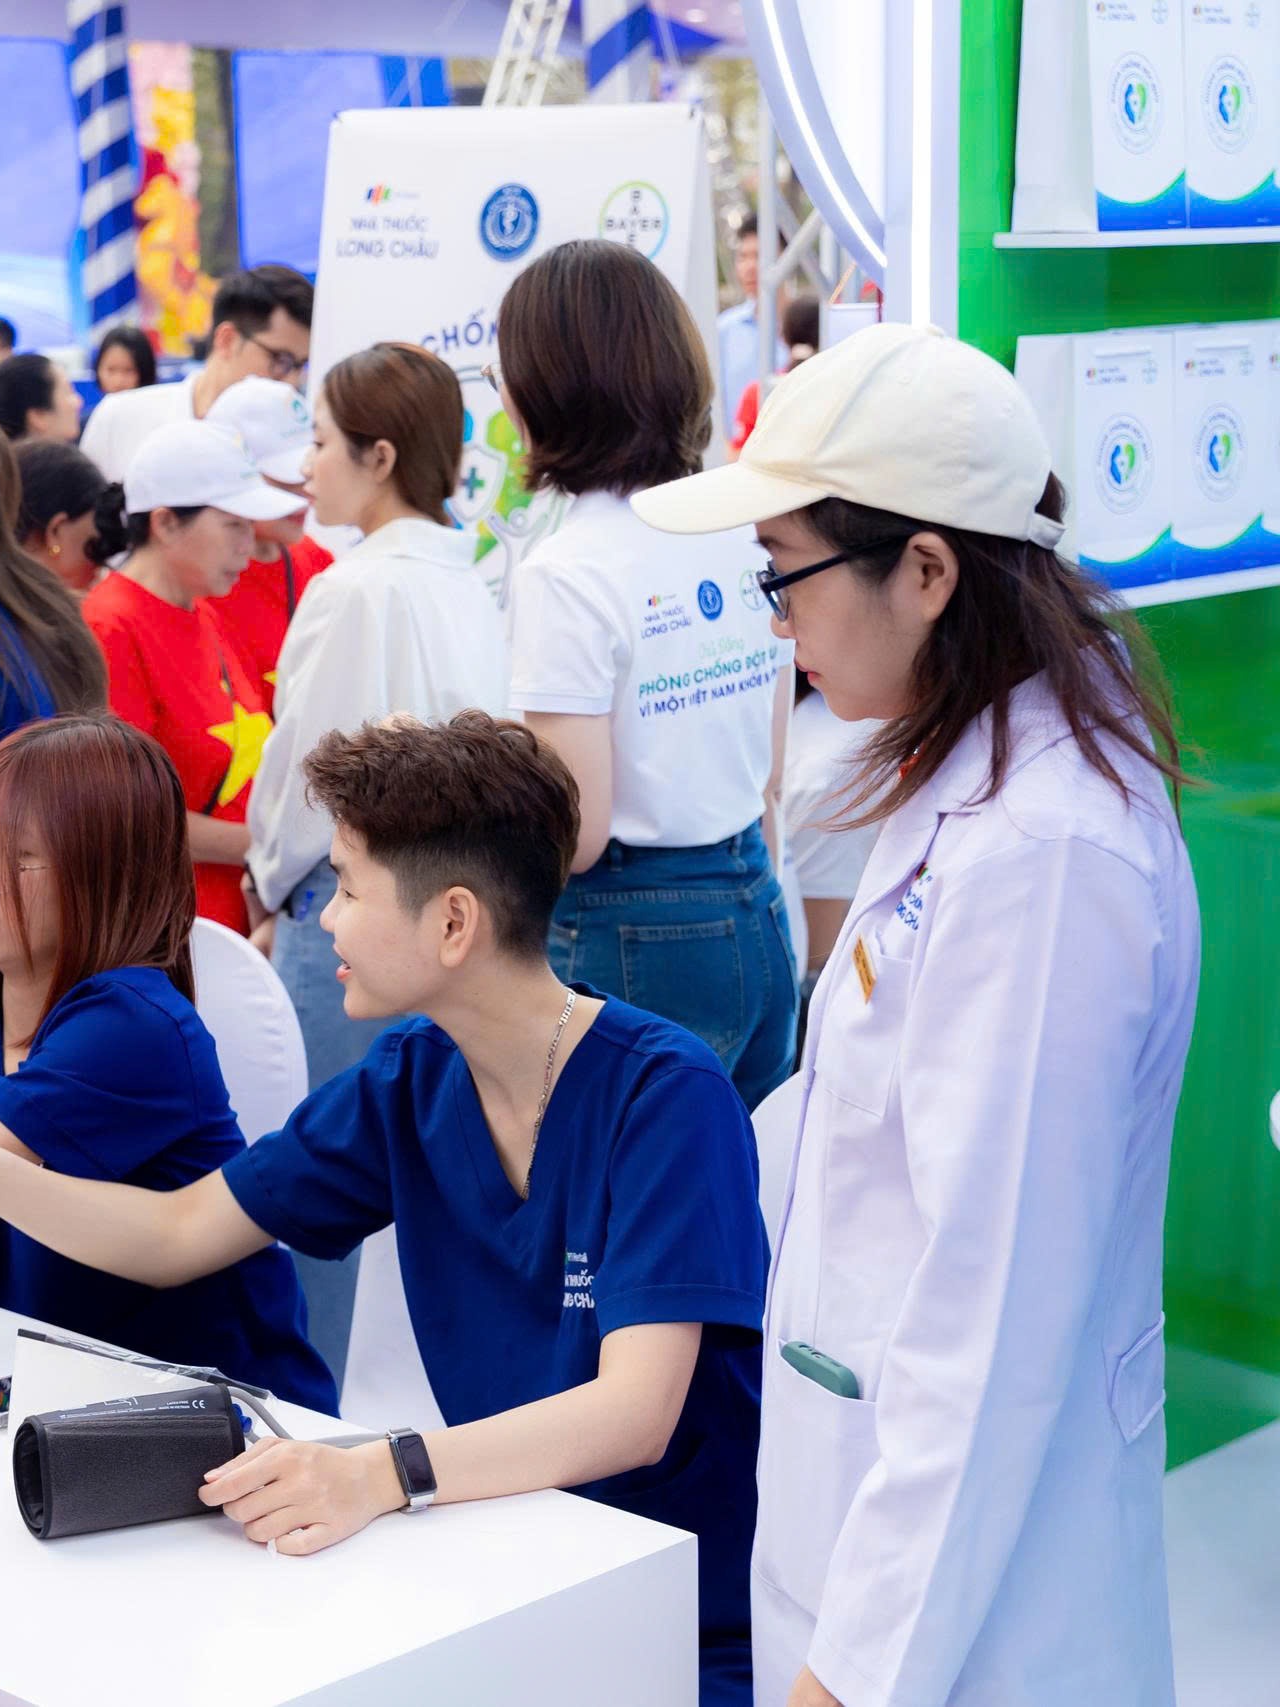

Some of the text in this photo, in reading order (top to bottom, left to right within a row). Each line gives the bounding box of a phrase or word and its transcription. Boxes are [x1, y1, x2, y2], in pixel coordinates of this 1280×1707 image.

[605, 217, 662, 232] BAYER
[336, 238, 385, 258] LONG
[641, 622, 669, 640] LONG
[638, 671, 690, 699] PHÒNG
[693, 658, 742, 685] CHỐNG
[639, 703, 651, 718] VÌ
[654, 696, 686, 716] MỘT
[711, 683, 736, 701] NAM
